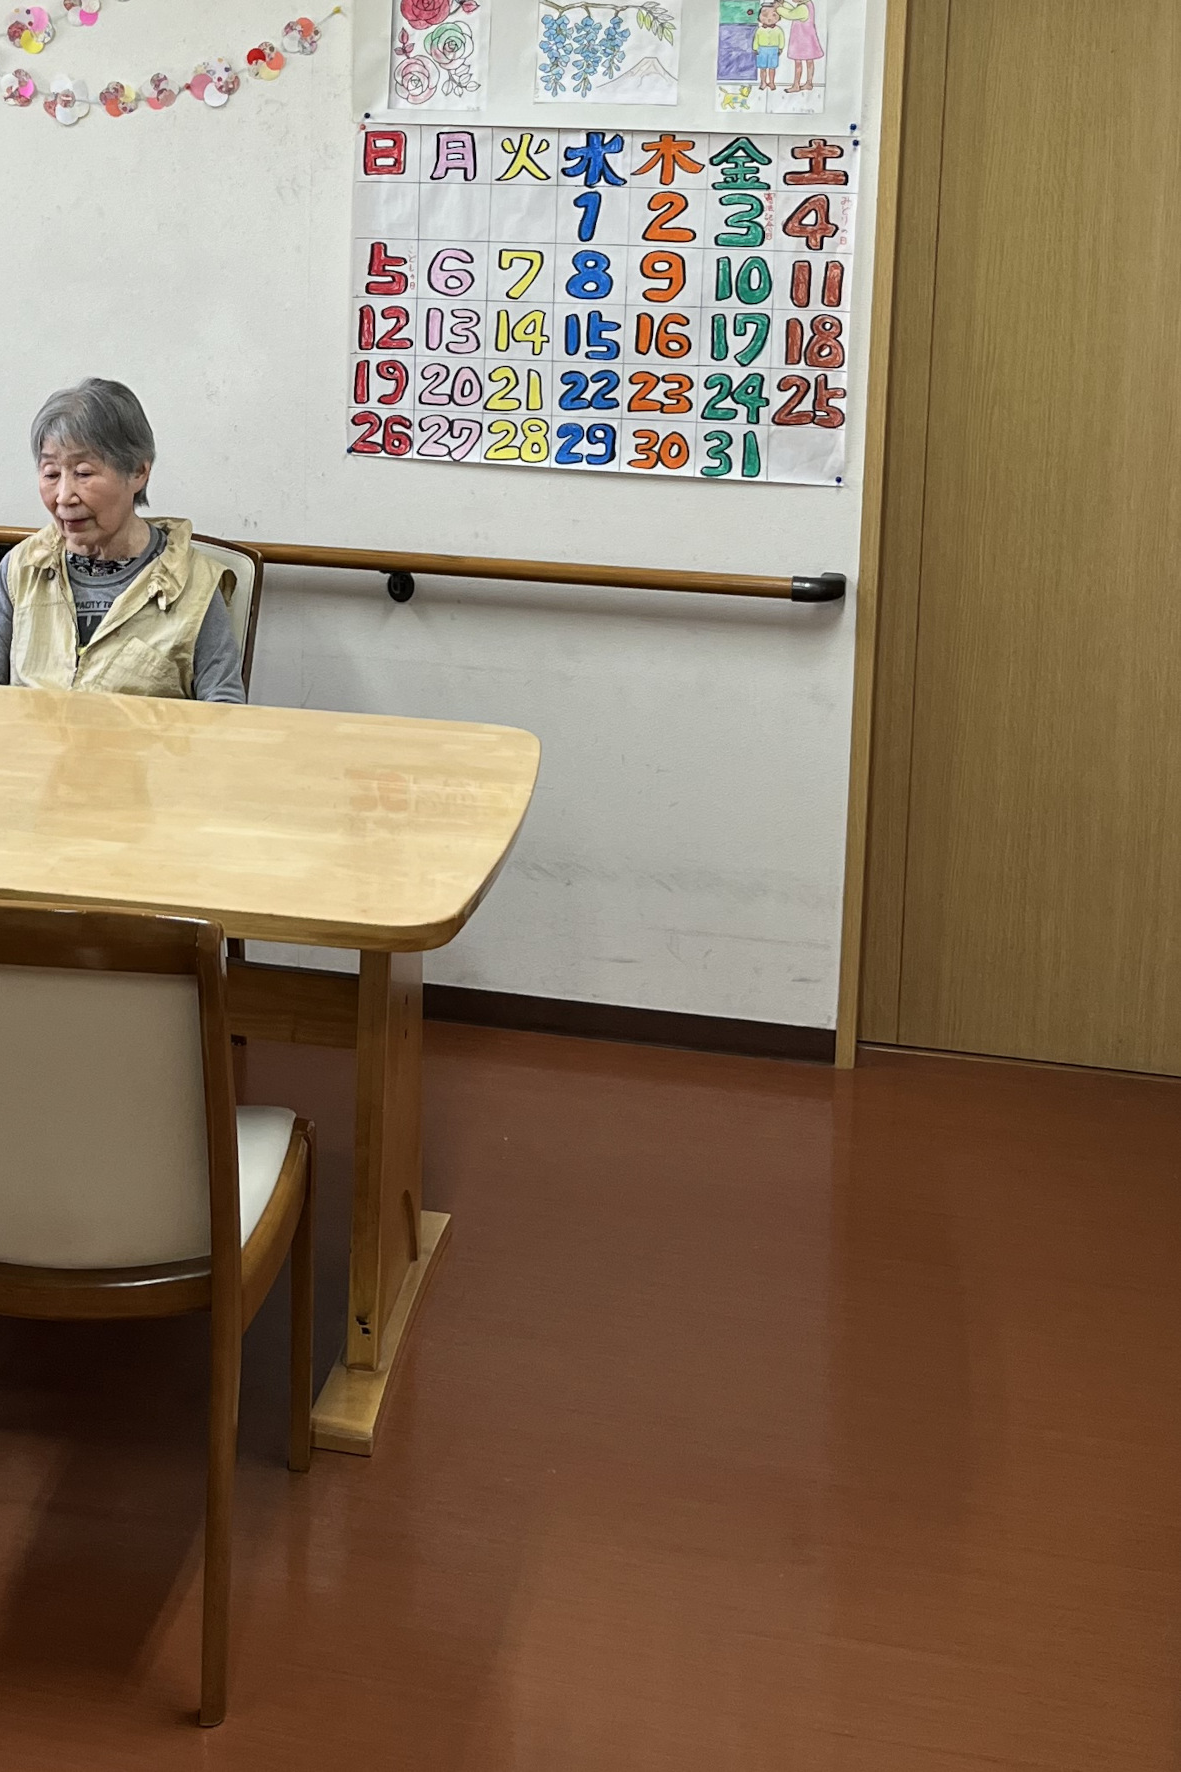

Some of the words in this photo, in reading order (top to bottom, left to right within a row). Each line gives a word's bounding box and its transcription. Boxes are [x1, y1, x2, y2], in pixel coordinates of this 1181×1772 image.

[364, 131, 407, 175] 日
[430, 131, 476, 181] 月
[496, 133, 551, 181] 火
[561, 132, 627, 188] 水
[635, 134, 705, 185] 木
[709, 137, 772, 190] 金
[783, 139, 848, 185] 土
[574, 192, 601, 242] 1
[642, 191, 696, 242] 2
[715, 194, 765, 247] 3
[783, 194, 839, 250] 4
[365, 242, 408, 295] 5
[428, 249, 474, 296] 6
[499, 249, 543, 299] 7
[566, 250, 613, 299] 8
[640, 251, 686, 302] 9
[716, 257, 772, 304] 10
[790, 261, 844, 308] 11
[359, 305, 413, 350] 12
[426, 308, 480, 354] 13
[495, 310, 549, 355] 14
[565, 311, 621, 360] 15
[635, 313, 691, 358] 16
[711, 313, 770, 367] 17
[785, 314, 844, 368] 18
[354, 360, 409, 404] 19
[419, 363, 482, 406] 20
[483, 366, 542, 411] 21
[559, 370, 620, 410] 22
[628, 371, 693, 413] 23
[701, 373, 769, 424] 24
[772, 374, 845, 428] 25
[351, 411, 413, 456] 26
[417, 415, 482, 462] 27
[484, 418, 549, 462] 28
[555, 424, 616, 464] 29
[627, 430, 689, 469] 30
[701, 431, 760, 477] 31
